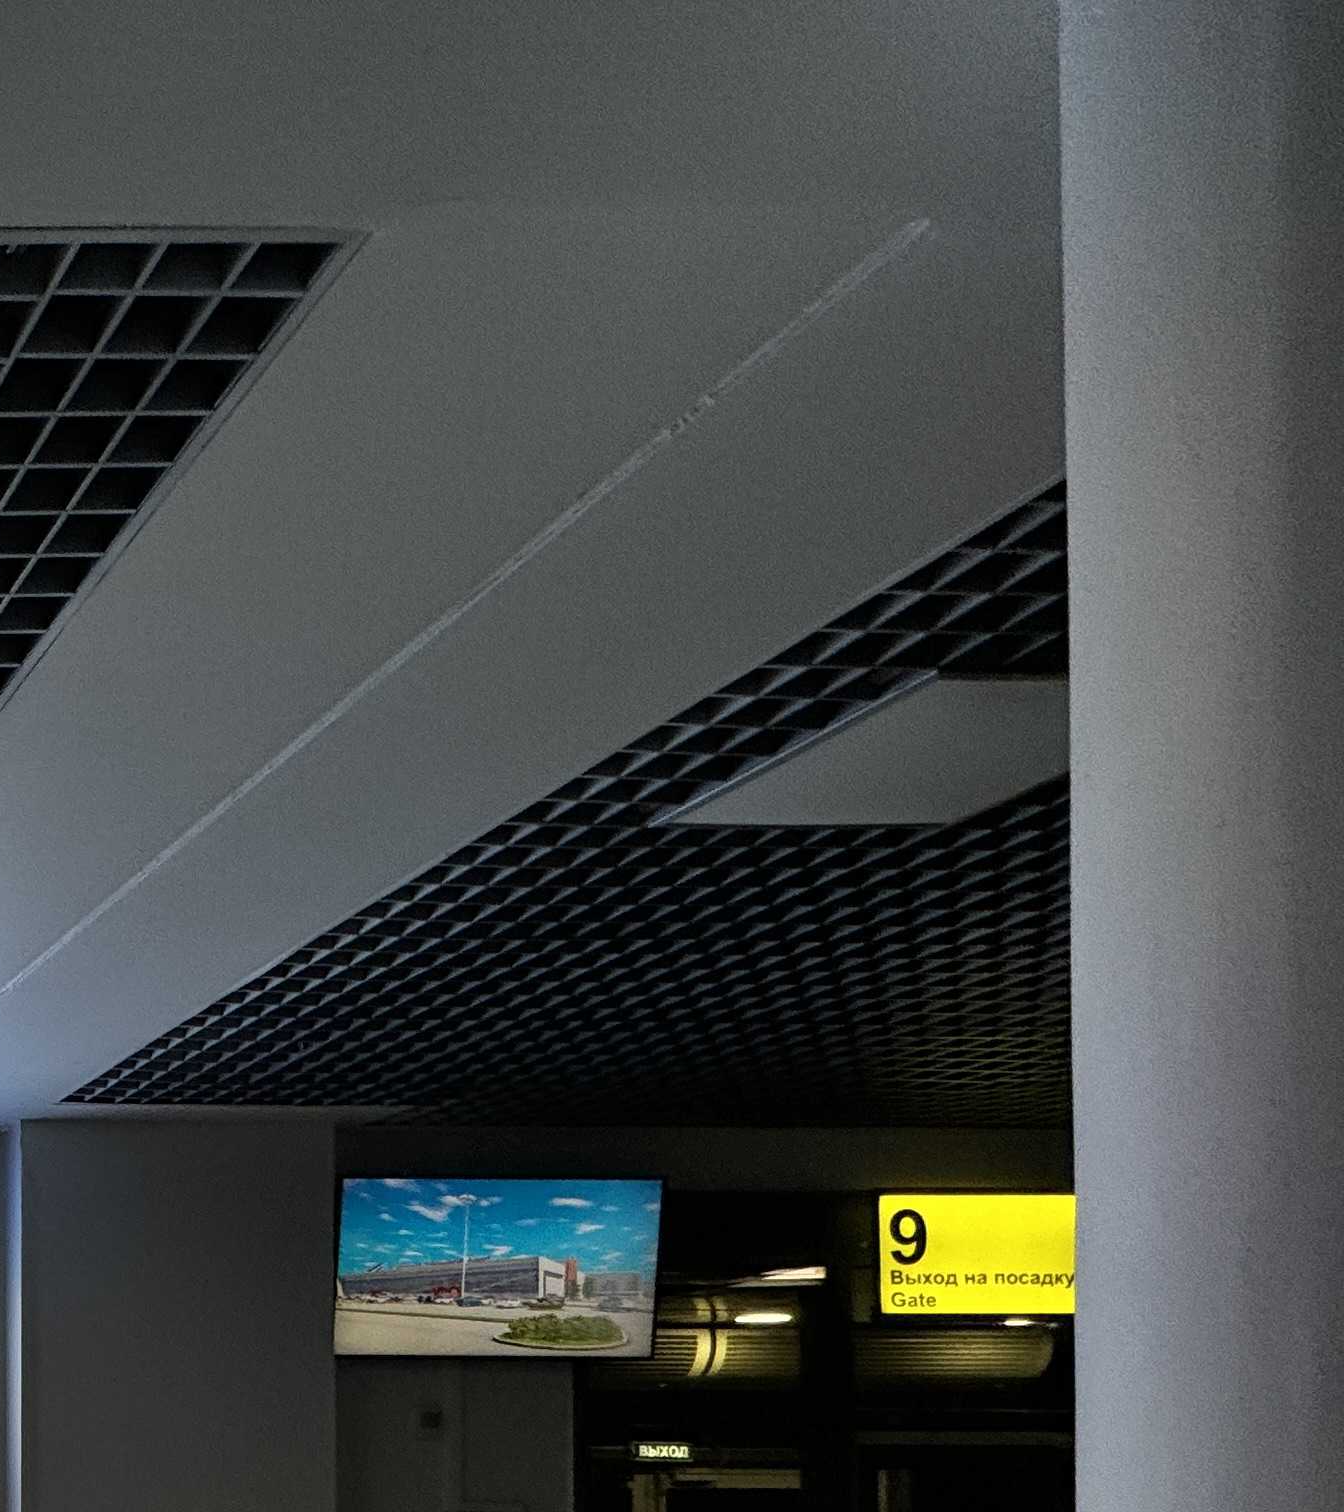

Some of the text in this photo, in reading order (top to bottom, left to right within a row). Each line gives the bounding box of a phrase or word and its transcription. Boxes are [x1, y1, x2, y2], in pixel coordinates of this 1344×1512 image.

[889, 1208, 927, 1265] 9
[890, 1270, 1075, 1288] Выход на посадку
[890, 1292, 937, 1307] Gate
[638, 1445, 689, 1458] ВЫХОД
